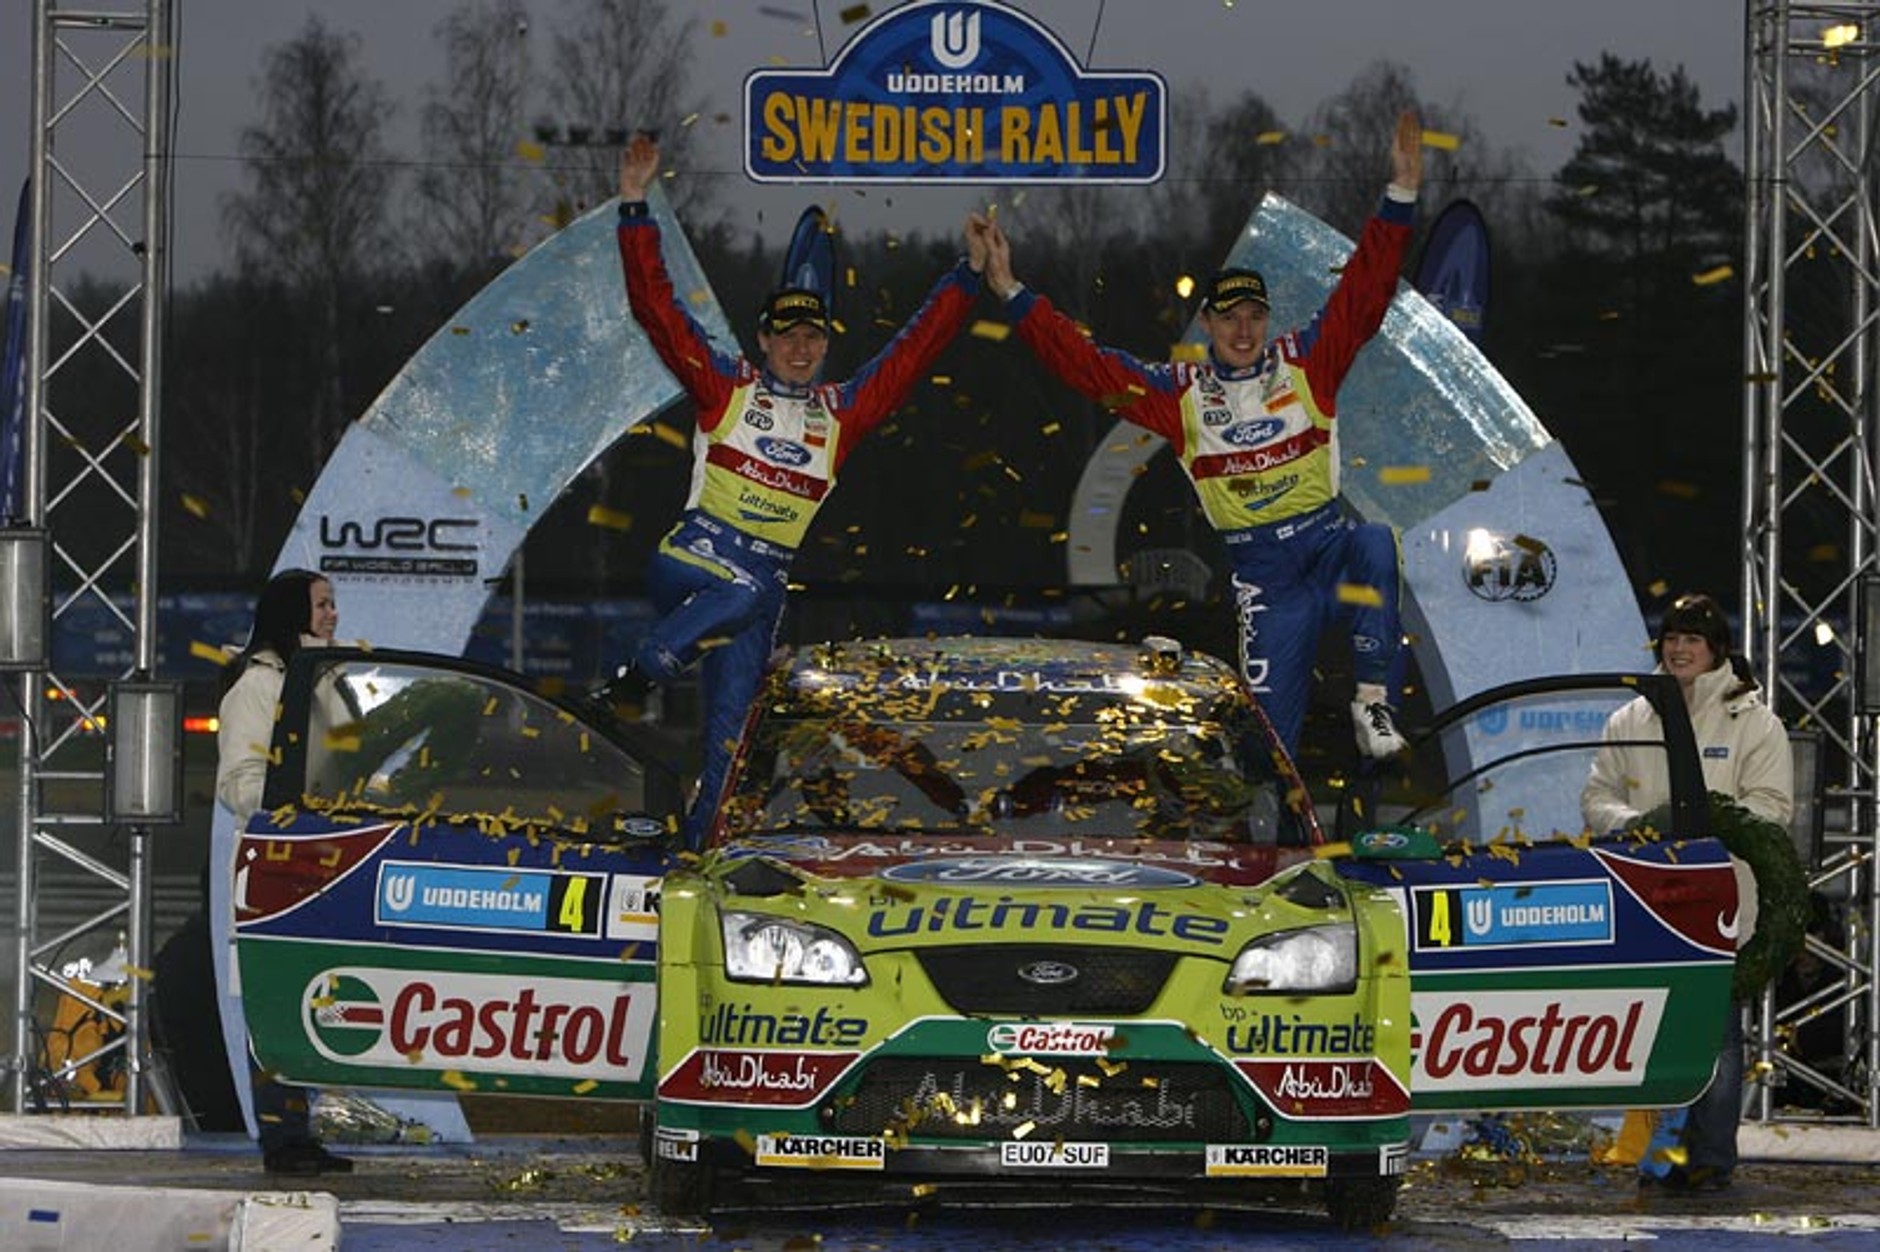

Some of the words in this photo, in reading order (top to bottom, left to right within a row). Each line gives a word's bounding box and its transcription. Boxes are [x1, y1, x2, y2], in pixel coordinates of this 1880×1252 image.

[887, 74, 1024, 94] UDDEHOLM
[762, 92, 983, 165] SWEDISH
[1001, 91, 1147, 165] RALLY
[320, 515, 479, 551] WRC
[939, 858, 1140, 885] Ford
[422, 887, 542, 913] UDDEHOLM
[558, 876, 588, 932] 4
[867, 896, 1231, 945] ultimate
[1429, 890, 1451, 947] 4
[1502, 904, 1605, 927] UDDEHOLM
[389, 982, 633, 1067] Castrol
[700, 1002, 868, 1046] ultimate
[1018, 1026, 1106, 1051] Castrol
[1226, 1012, 1376, 1054] ultimate
[1423, 1001, 1644, 1079] Castrol
[1005, 1144, 1054, 1163] EU07
[1064, 1145, 1107, 1163] SUF
